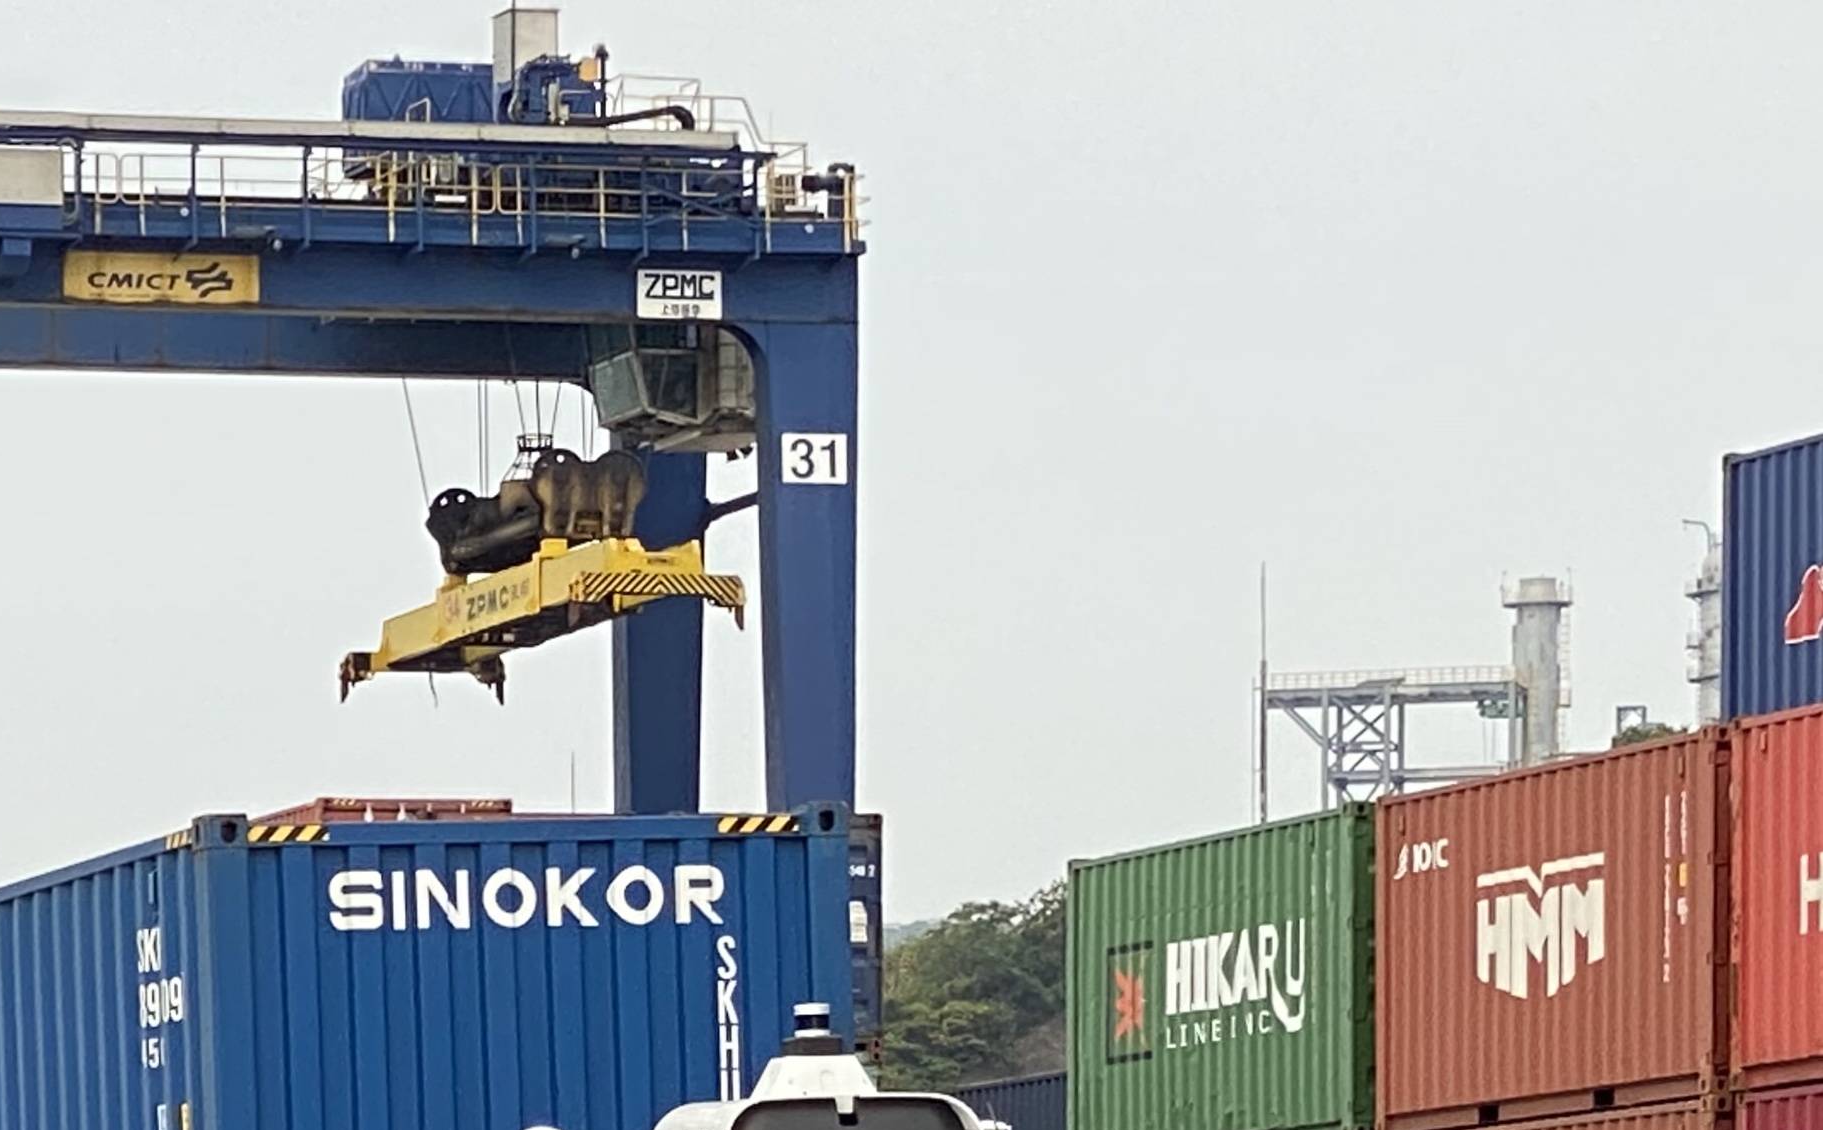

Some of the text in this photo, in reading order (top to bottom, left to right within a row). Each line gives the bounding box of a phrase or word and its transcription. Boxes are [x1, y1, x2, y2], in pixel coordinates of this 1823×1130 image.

[87, 271, 181, 291] CMICT
[643, 273, 715, 300] ZPMC
[790, 438, 837, 479] 31
[329, 864, 725, 931] SINOKOR
[1477, 853, 1605, 1000] HMM
[1165, 917, 1306, 1033] HIKARU
